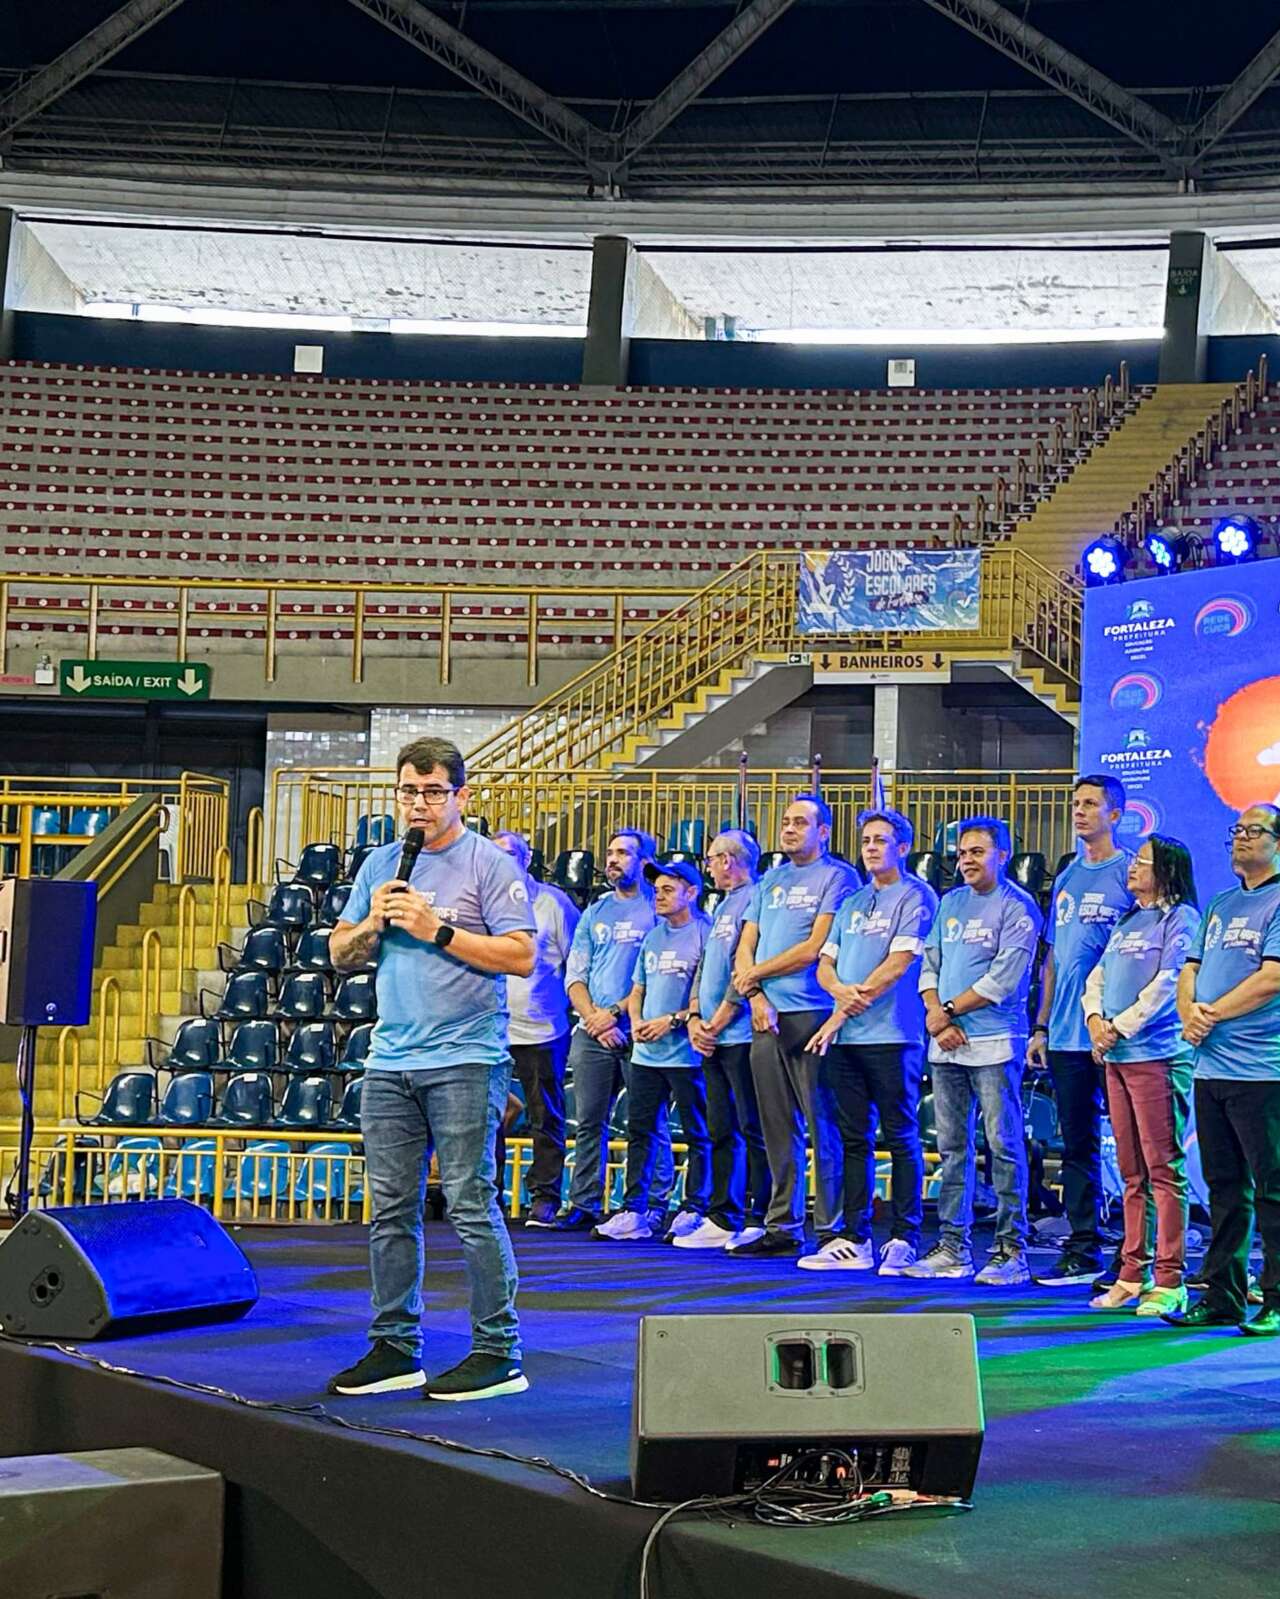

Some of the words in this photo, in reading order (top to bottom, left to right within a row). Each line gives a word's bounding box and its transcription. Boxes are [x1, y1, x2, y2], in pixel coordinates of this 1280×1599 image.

[1104, 618, 1176, 636] FORTALEZA
[1113, 630, 1167, 642] PREFEITURA
[839, 655, 924, 669] BANHEIROS
[93, 673, 134, 687] SAÍDA
[143, 677, 172, 688] EXIT
[1101, 749, 1172, 763] FORTALEZA
[1110, 761, 1163, 770] PREFEITURA
